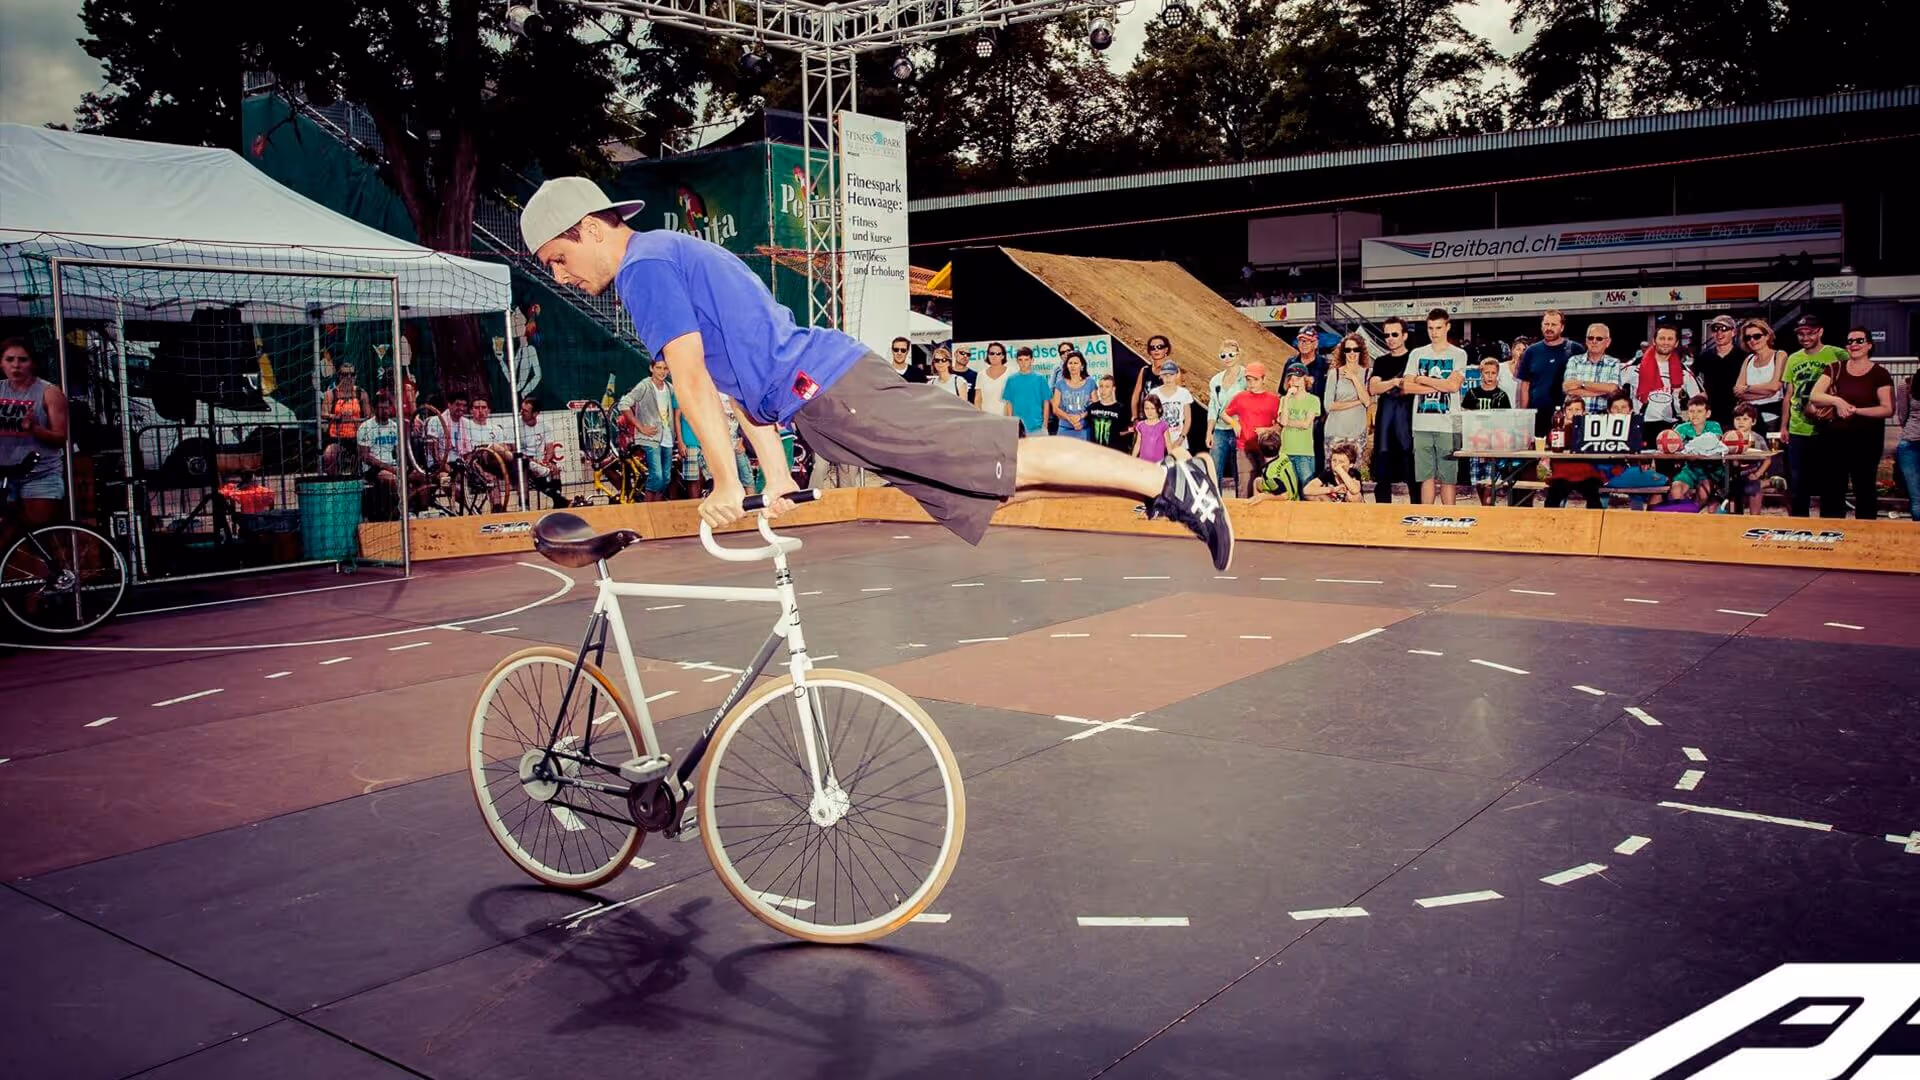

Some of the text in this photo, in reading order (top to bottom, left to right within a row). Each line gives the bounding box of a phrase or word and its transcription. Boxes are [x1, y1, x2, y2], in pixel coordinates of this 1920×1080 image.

[883, 137, 901, 148] PARK
[847, 172, 902, 195] Fitnesspark
[848, 191, 902, 214] Heuwaage:
[852, 215, 878, 228] Fitness
[852, 230, 892, 243] und Kurse
[1432, 233, 1557, 258] Breitband.ch
[853, 250, 887, 262] Wellness
[853, 265, 905, 280] und Erholung
[1606, 290, 1626, 301] ASAG
[1085, 340, 1107, 356] AG
[1792, 362, 1809, 374] NEW
[1581, 441, 1631, 451] STIGA
